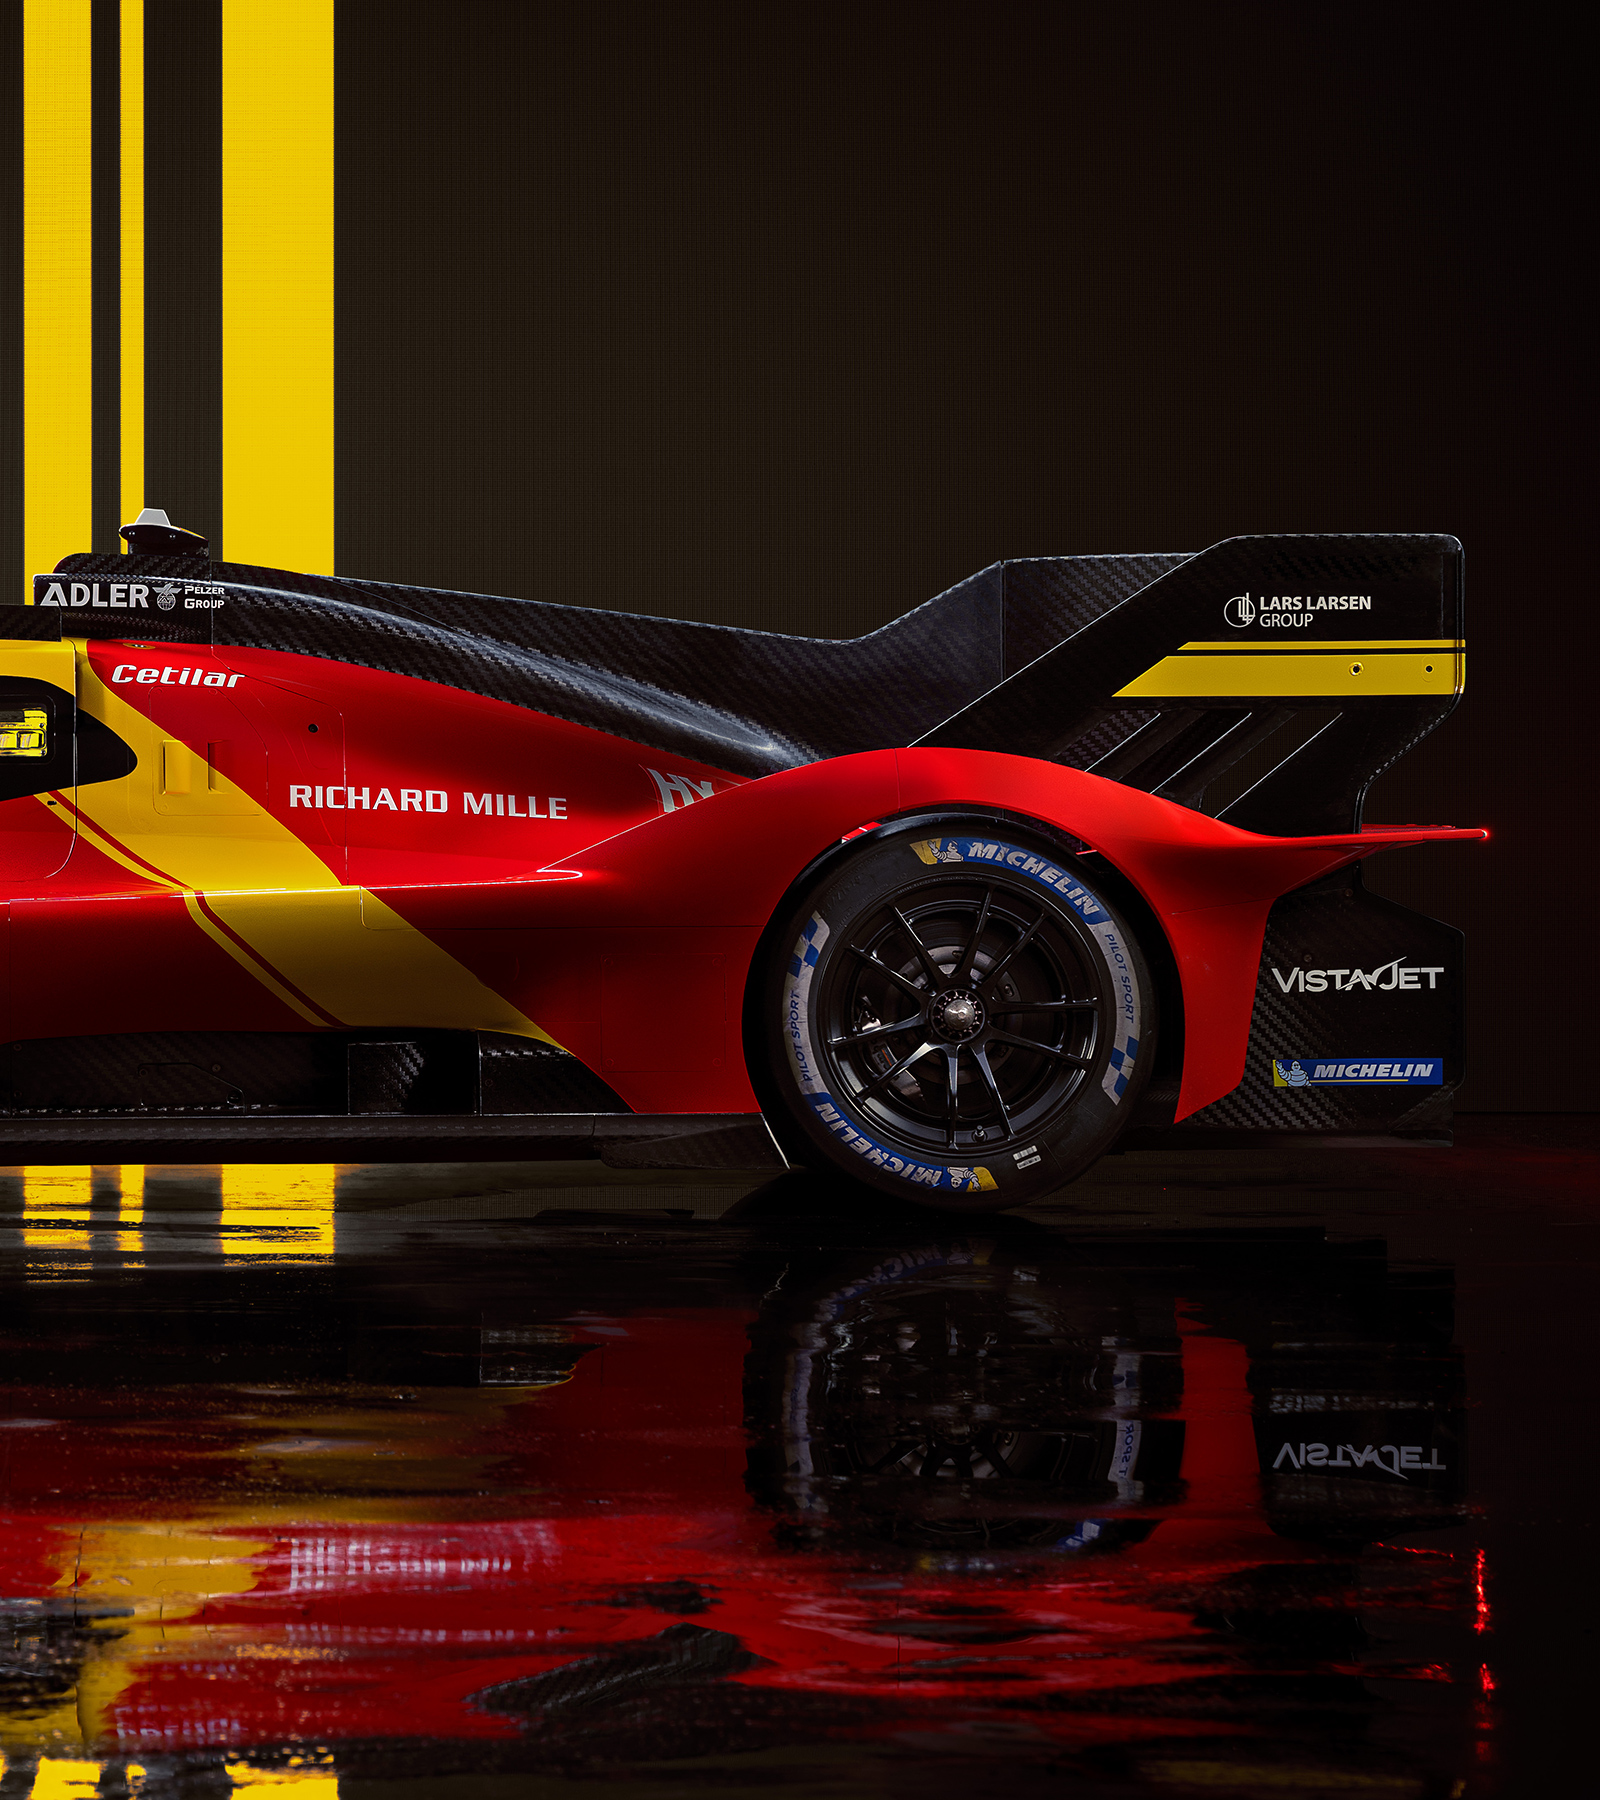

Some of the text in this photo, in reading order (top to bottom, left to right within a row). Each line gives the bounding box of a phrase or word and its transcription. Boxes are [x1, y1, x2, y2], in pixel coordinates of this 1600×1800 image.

[40, 583, 149, 608] ADLER
[184, 585, 225, 595] PELZER
[184, 598, 225, 609] GROUP
[1260, 595, 1371, 611] LARS LARSEN
[1260, 612, 1313, 627] GROUP
[111, 664, 245, 688] Cetilar
[289, 784, 568, 820] RICHARD MILLE
[967, 841, 1100, 917] MICHELIN
[1104, 933, 1136, 1024] PILOT SPORT
[790, 989, 813, 1083] PILOT SPORT
[1314, 1062, 1433, 1079] MICHELIN
[815, 1101, 944, 1186] MICHELIN
